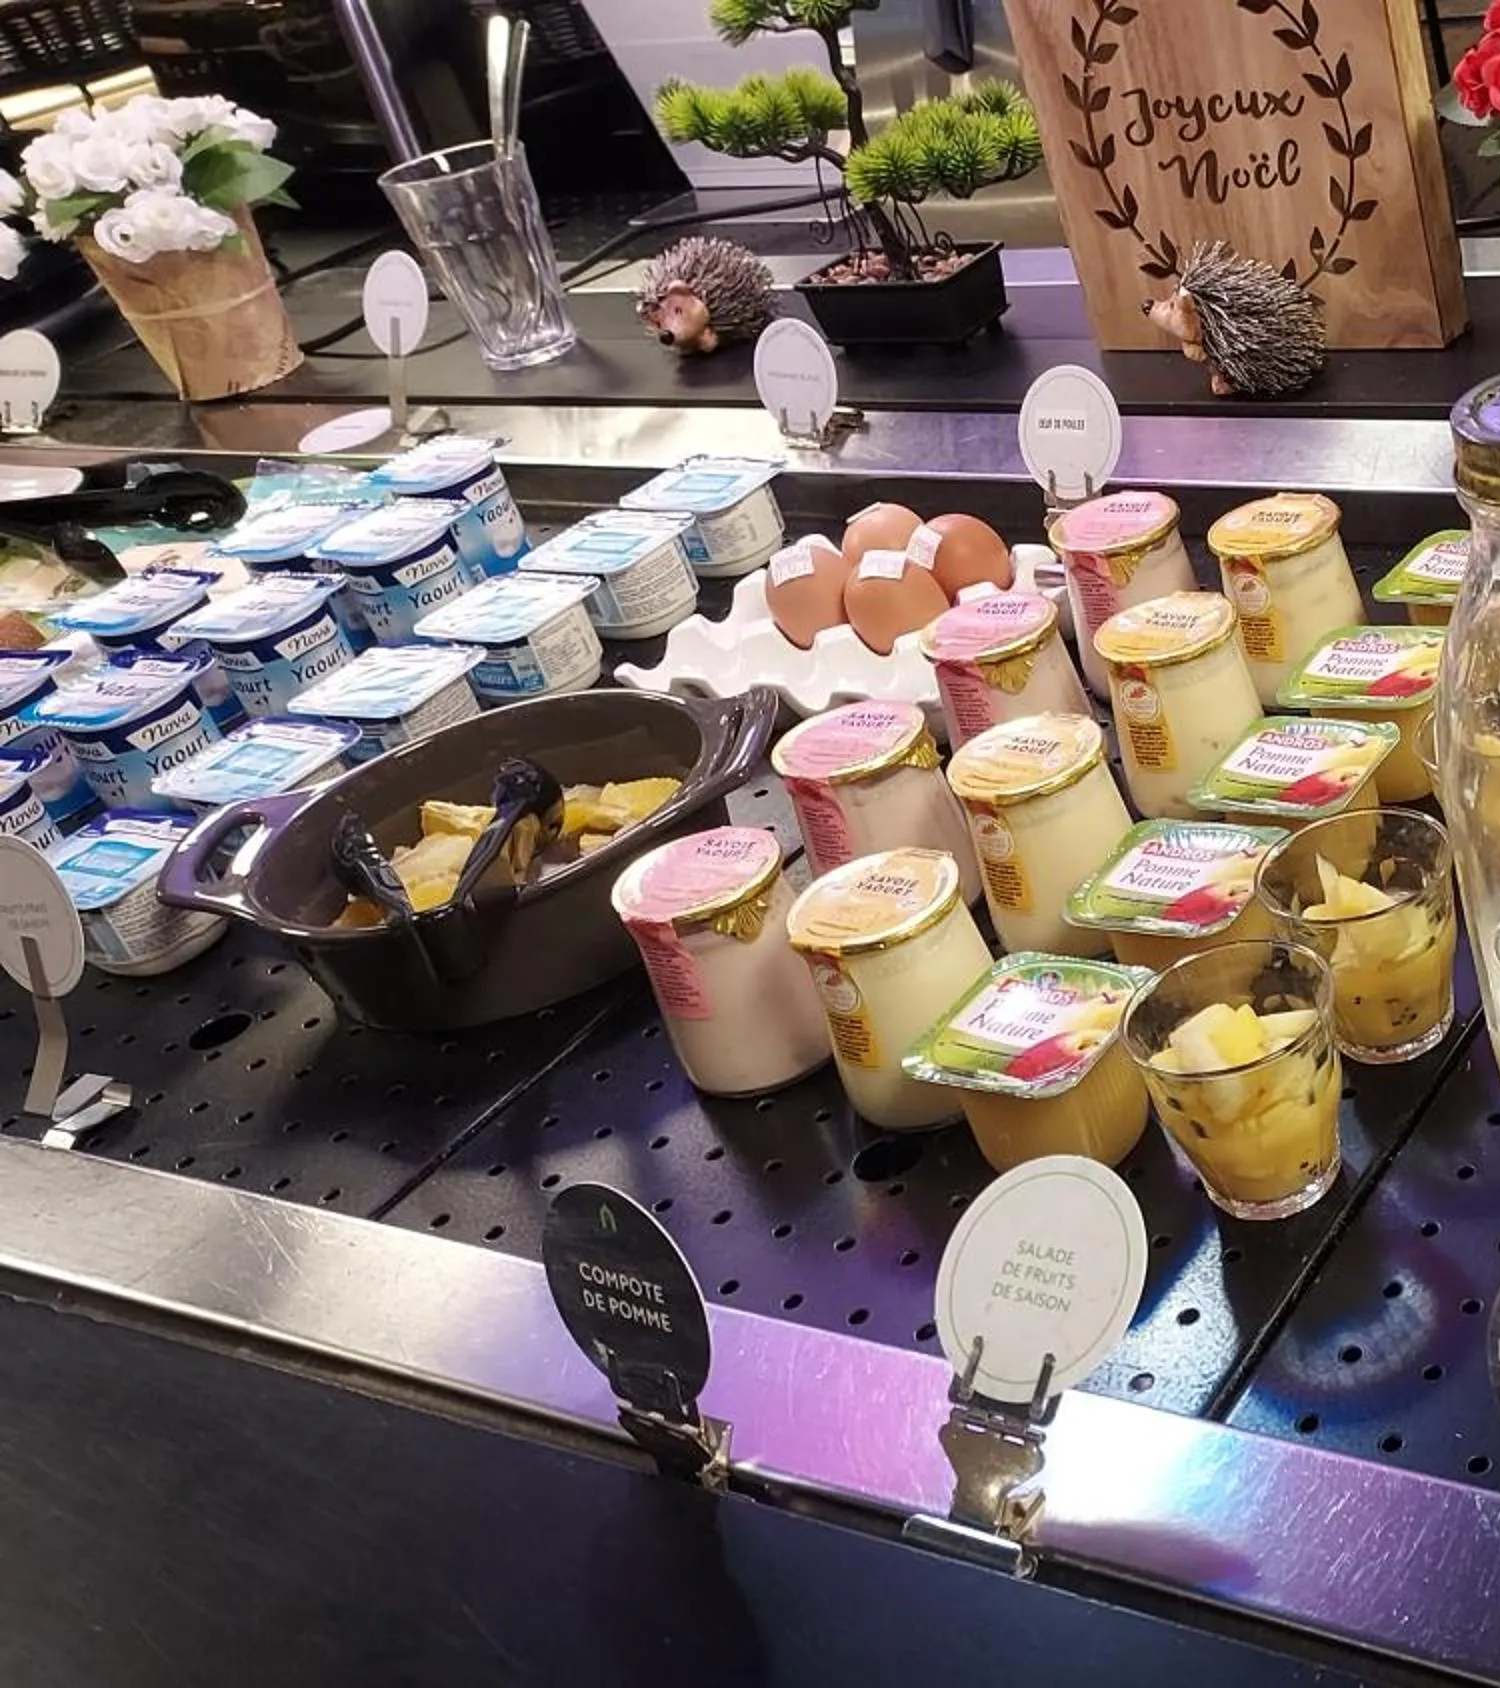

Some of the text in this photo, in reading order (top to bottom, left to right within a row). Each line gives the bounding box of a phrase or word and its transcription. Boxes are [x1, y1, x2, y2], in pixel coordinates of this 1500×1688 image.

[1120, 87, 1305, 147] Joyeux
[1157, 138, 1301, 205] Noël
[407, 571, 465, 609] Yaourt
[287, 623, 331, 650] Nova
[289, 642, 348, 684] Yaourt
[1317, 662, 1384, 677] Nature
[1326, 652, 1389, 667] Pomme
[141, 709, 193, 744] Nova
[1257, 732, 1327, 750] ANDROS
[145, 728, 213, 777] Yaourt
[1236, 757, 1306, 777] Nature
[1248, 746, 1313, 764] Pomme
[1119, 872, 1192, 892] Nature
[1132, 857, 1201, 880] Pomme
[968, 1012, 1046, 1042] Nature
[1016, 1239, 1076, 1267] SALADE
[579, 1261, 666, 1305] COMPOTE
[1001, 1260, 1077, 1291] DE FRUITS
[583, 1288, 673, 1333] DE POMME
[991, 1280, 1072, 1313] DE SAISON
